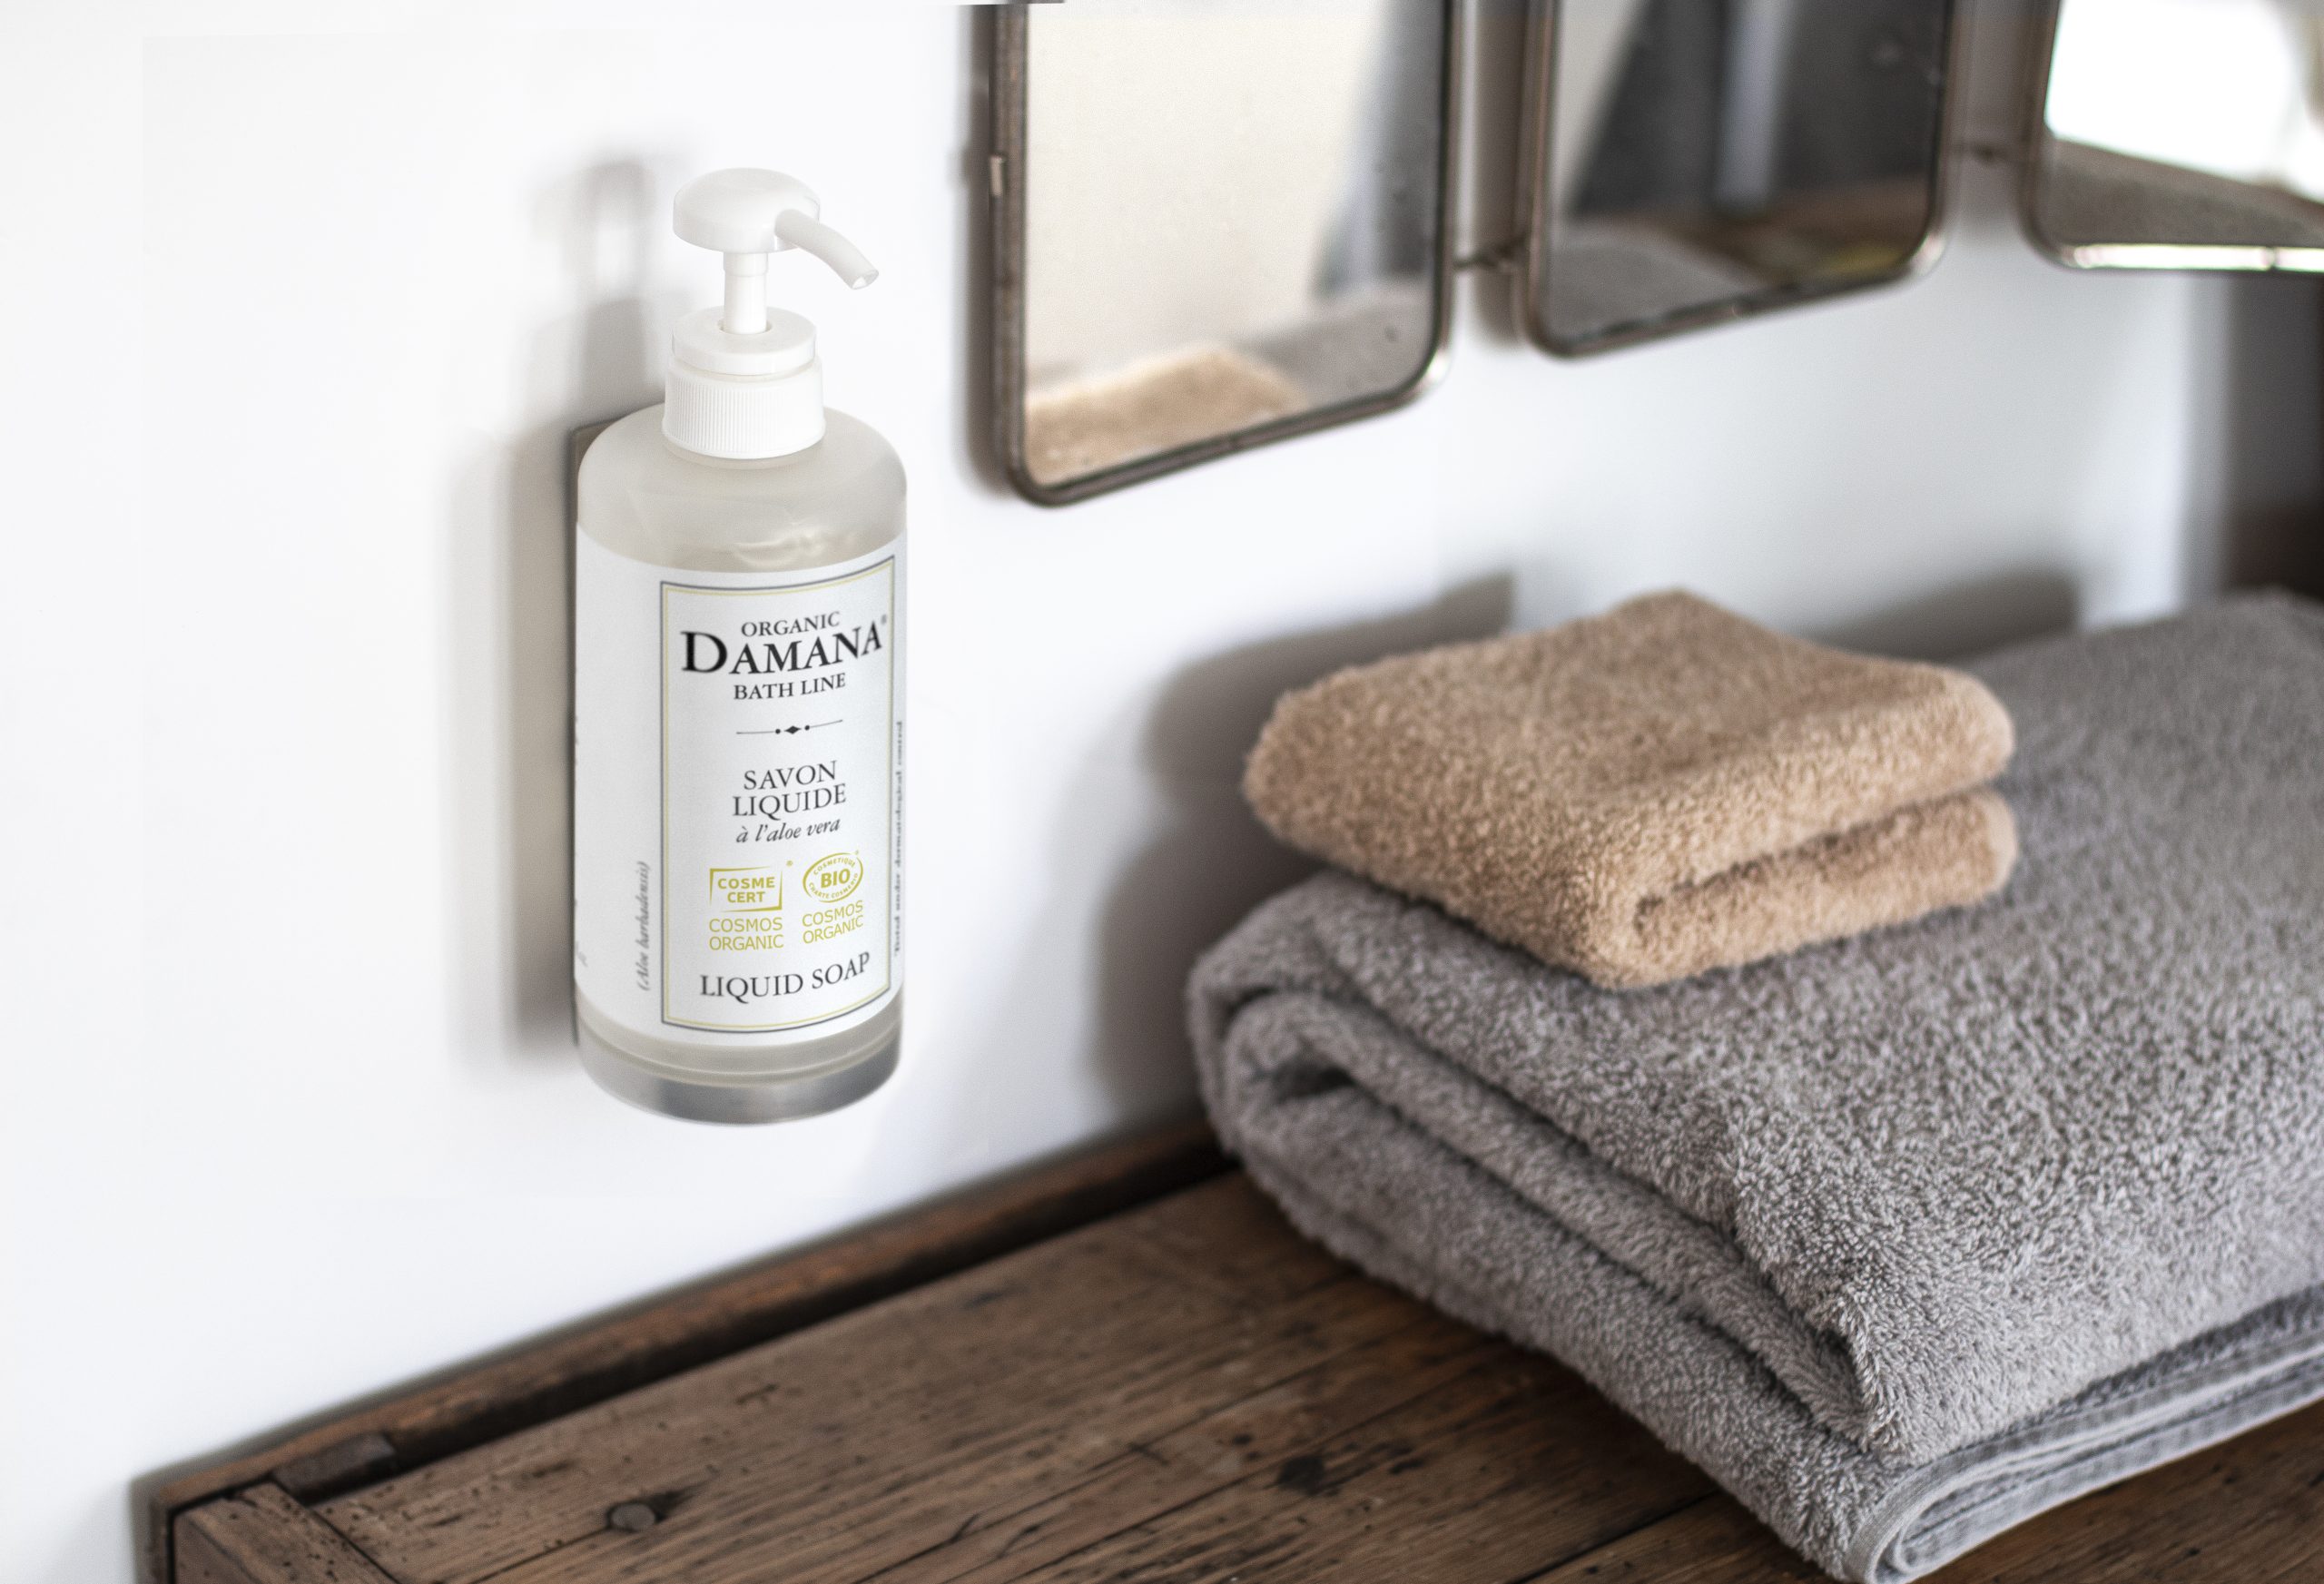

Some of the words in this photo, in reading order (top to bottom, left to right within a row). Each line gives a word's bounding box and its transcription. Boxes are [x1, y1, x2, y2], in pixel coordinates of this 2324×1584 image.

[741, 611, 840, 637] ORGANIC
[734, 683, 793, 700] BATH
[801, 673, 846, 695] LINE
[743, 761, 838, 791] SAVON
[732, 783, 847, 821] LIQUIDE
[735, 826, 749, 843] à
[807, 819, 841, 836] vera
[717, 877, 776, 890] COSME
[821, 868, 851, 889] BIO
[727, 891, 765, 903] CERT
[709, 917, 783, 933] COSMOS
[802, 900, 863, 927] COSMOS
[803, 914, 863, 944] ORGANIC
[709, 934, 784, 951] ORGANIC
[700, 973, 804, 1004] LIQUID
[812, 951, 872, 989] SOAP
